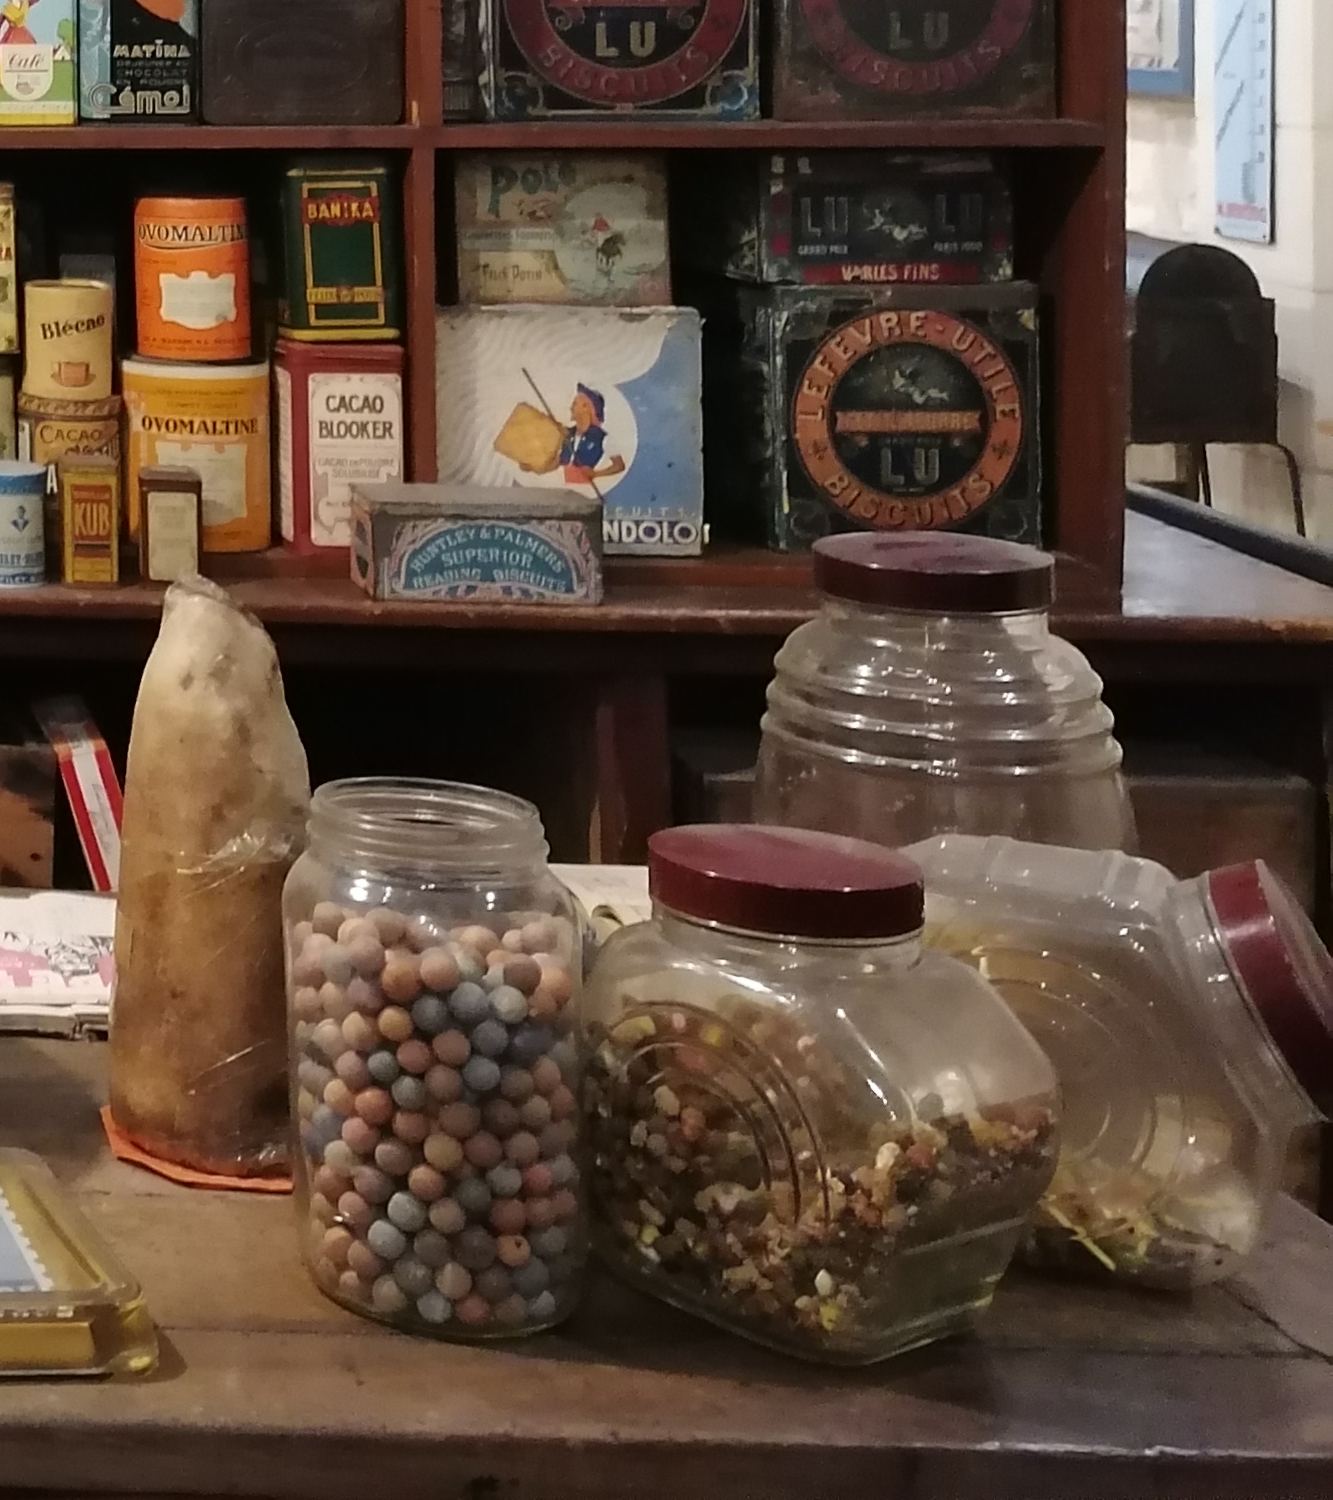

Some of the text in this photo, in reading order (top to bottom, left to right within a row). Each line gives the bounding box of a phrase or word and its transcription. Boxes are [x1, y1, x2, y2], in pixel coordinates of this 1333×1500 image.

[594, 21, 656, 58] LU
[889, 11, 949, 51] LU
[7, 52, 46, 70] Café
[40, 312, 106, 342] Blécao
[325, 394, 386, 414] CACAO
[39, 424, 103, 443] CACAO
[141, 415, 260, 436] OVOMALTINE
[317, 420, 394, 441] BLOOKER
[881, 447, 941, 487] LU
[822, 471, 995, 527] BISCUITS
[74, 500, 111, 537] KUB
[409, 527, 476, 573] HUNTLEY
[494, 525, 565, 574] PALMERS
[440, 547, 533, 570] SUPERIOR
[492, 568, 567, 594] BISCUITS
